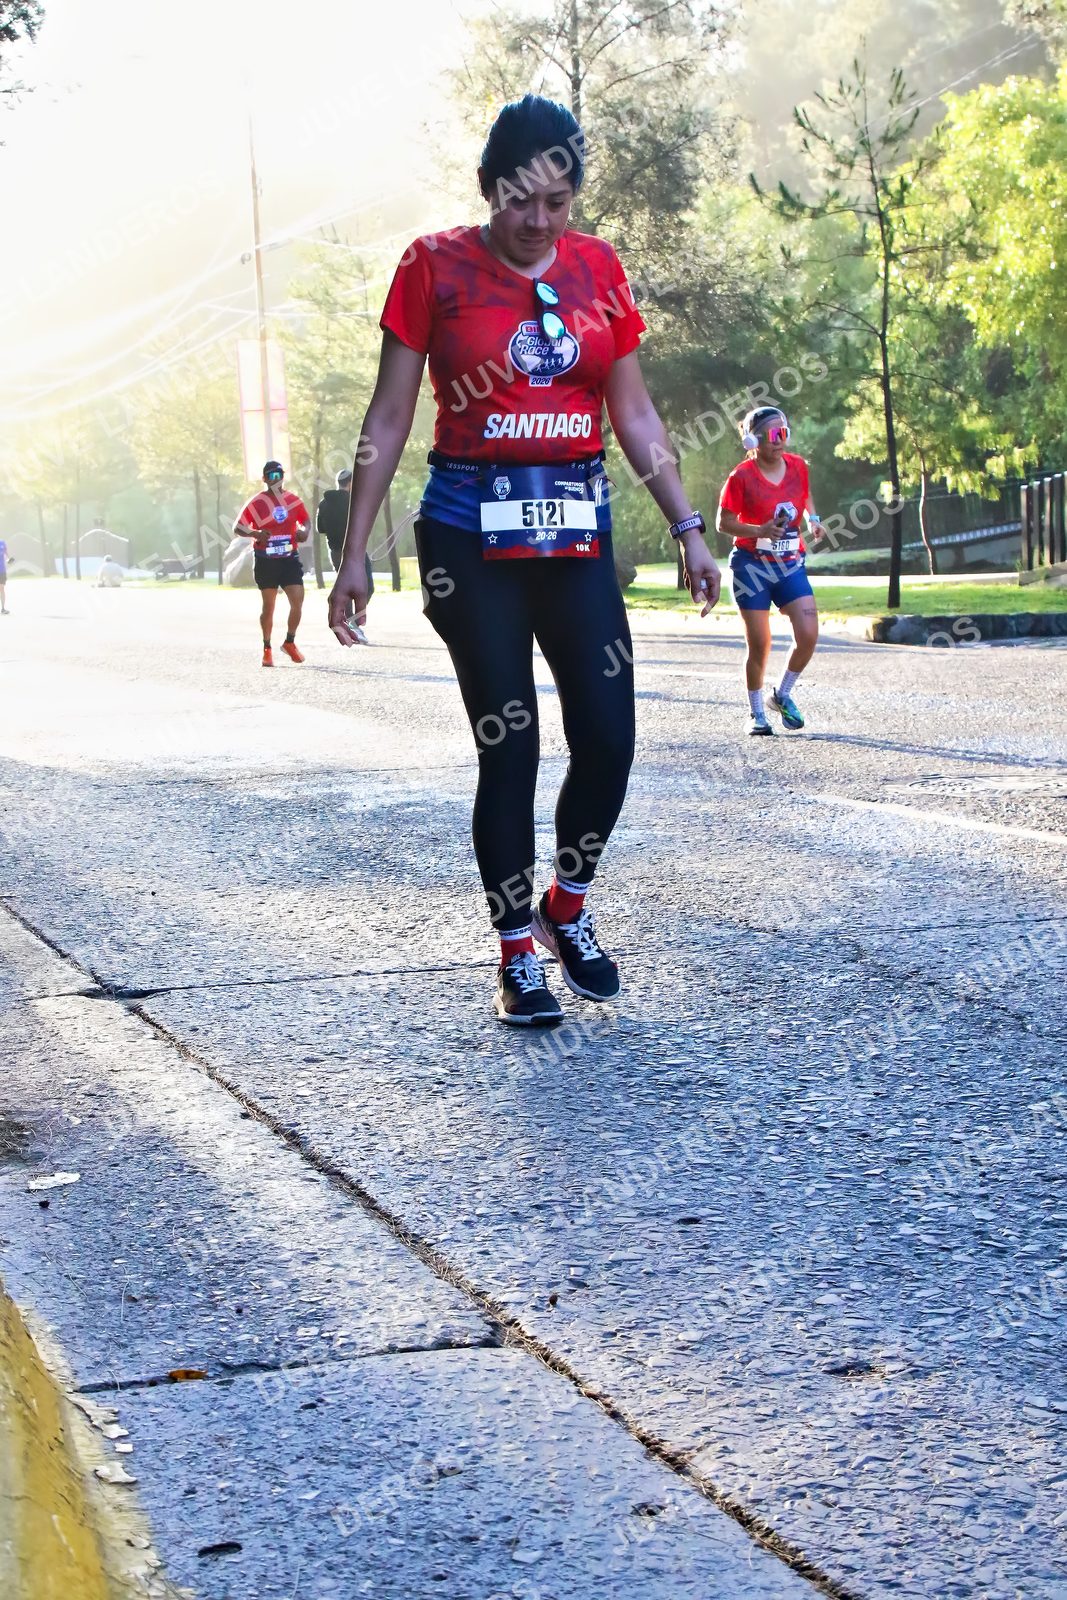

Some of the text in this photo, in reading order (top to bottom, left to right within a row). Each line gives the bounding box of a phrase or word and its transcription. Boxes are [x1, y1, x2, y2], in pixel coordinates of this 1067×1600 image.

[520, 344, 549, 355] Race
[531, 377, 551, 385] 2026
[484, 413, 592, 439] SANTIAGO
[521, 501, 566, 528] 5121
[575, 544, 591, 552] 10K
